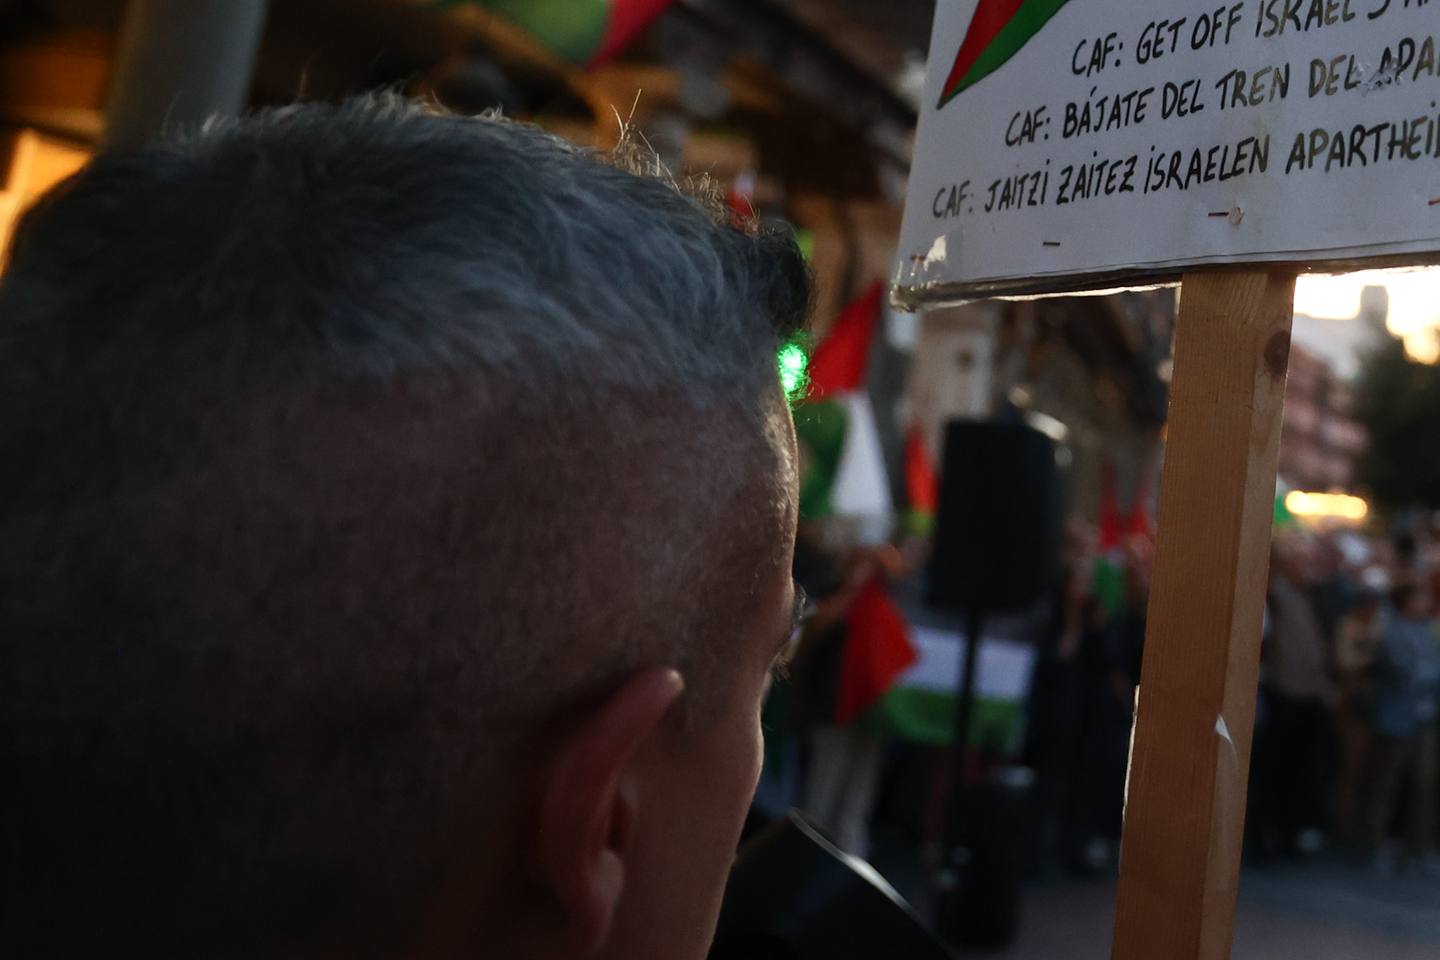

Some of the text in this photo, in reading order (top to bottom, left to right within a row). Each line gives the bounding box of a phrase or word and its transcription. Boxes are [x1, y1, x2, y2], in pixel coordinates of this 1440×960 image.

[1071, 32, 1123, 78] CAF:
[1135, 17, 1186, 65] GET
[1190, 1, 1244, 52] OFF
[1005, 105, 1050, 147] CAF:
[1062, 85, 1155, 140] BÁJATE
[1161, 81, 1204, 120] DEL
[1215, 62, 1291, 111] TREN
[1308, 53, 1361, 99] DEL
[932, 180, 974, 219] CAF:
